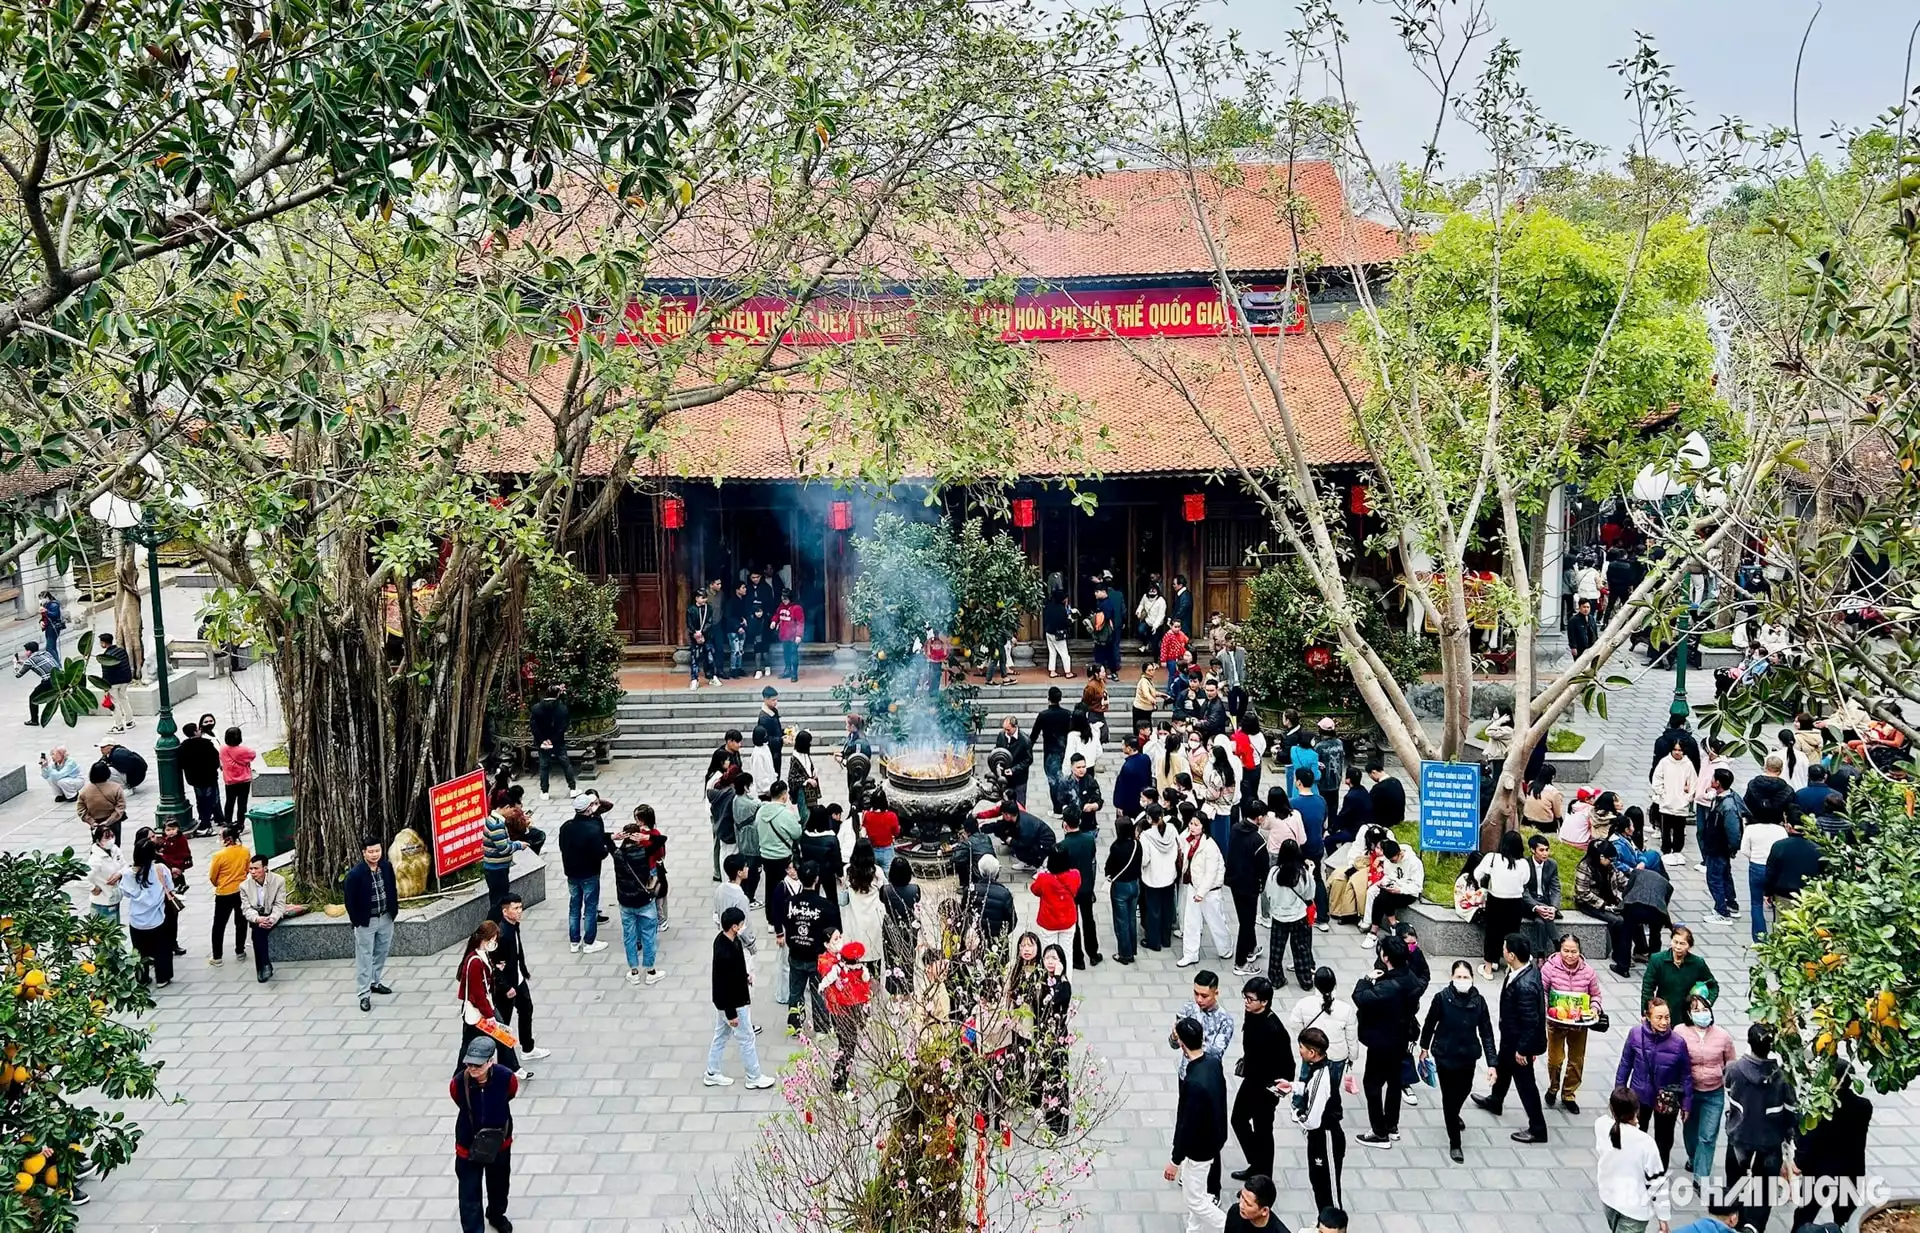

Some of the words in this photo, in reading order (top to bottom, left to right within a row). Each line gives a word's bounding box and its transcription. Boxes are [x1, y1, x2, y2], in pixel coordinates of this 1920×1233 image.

[1016, 303, 1047, 330] HÓA
[1116, 295, 1144, 327] THỂ
[1149, 295, 1191, 328] QUỐC
[1196, 301, 1223, 325] GIA
